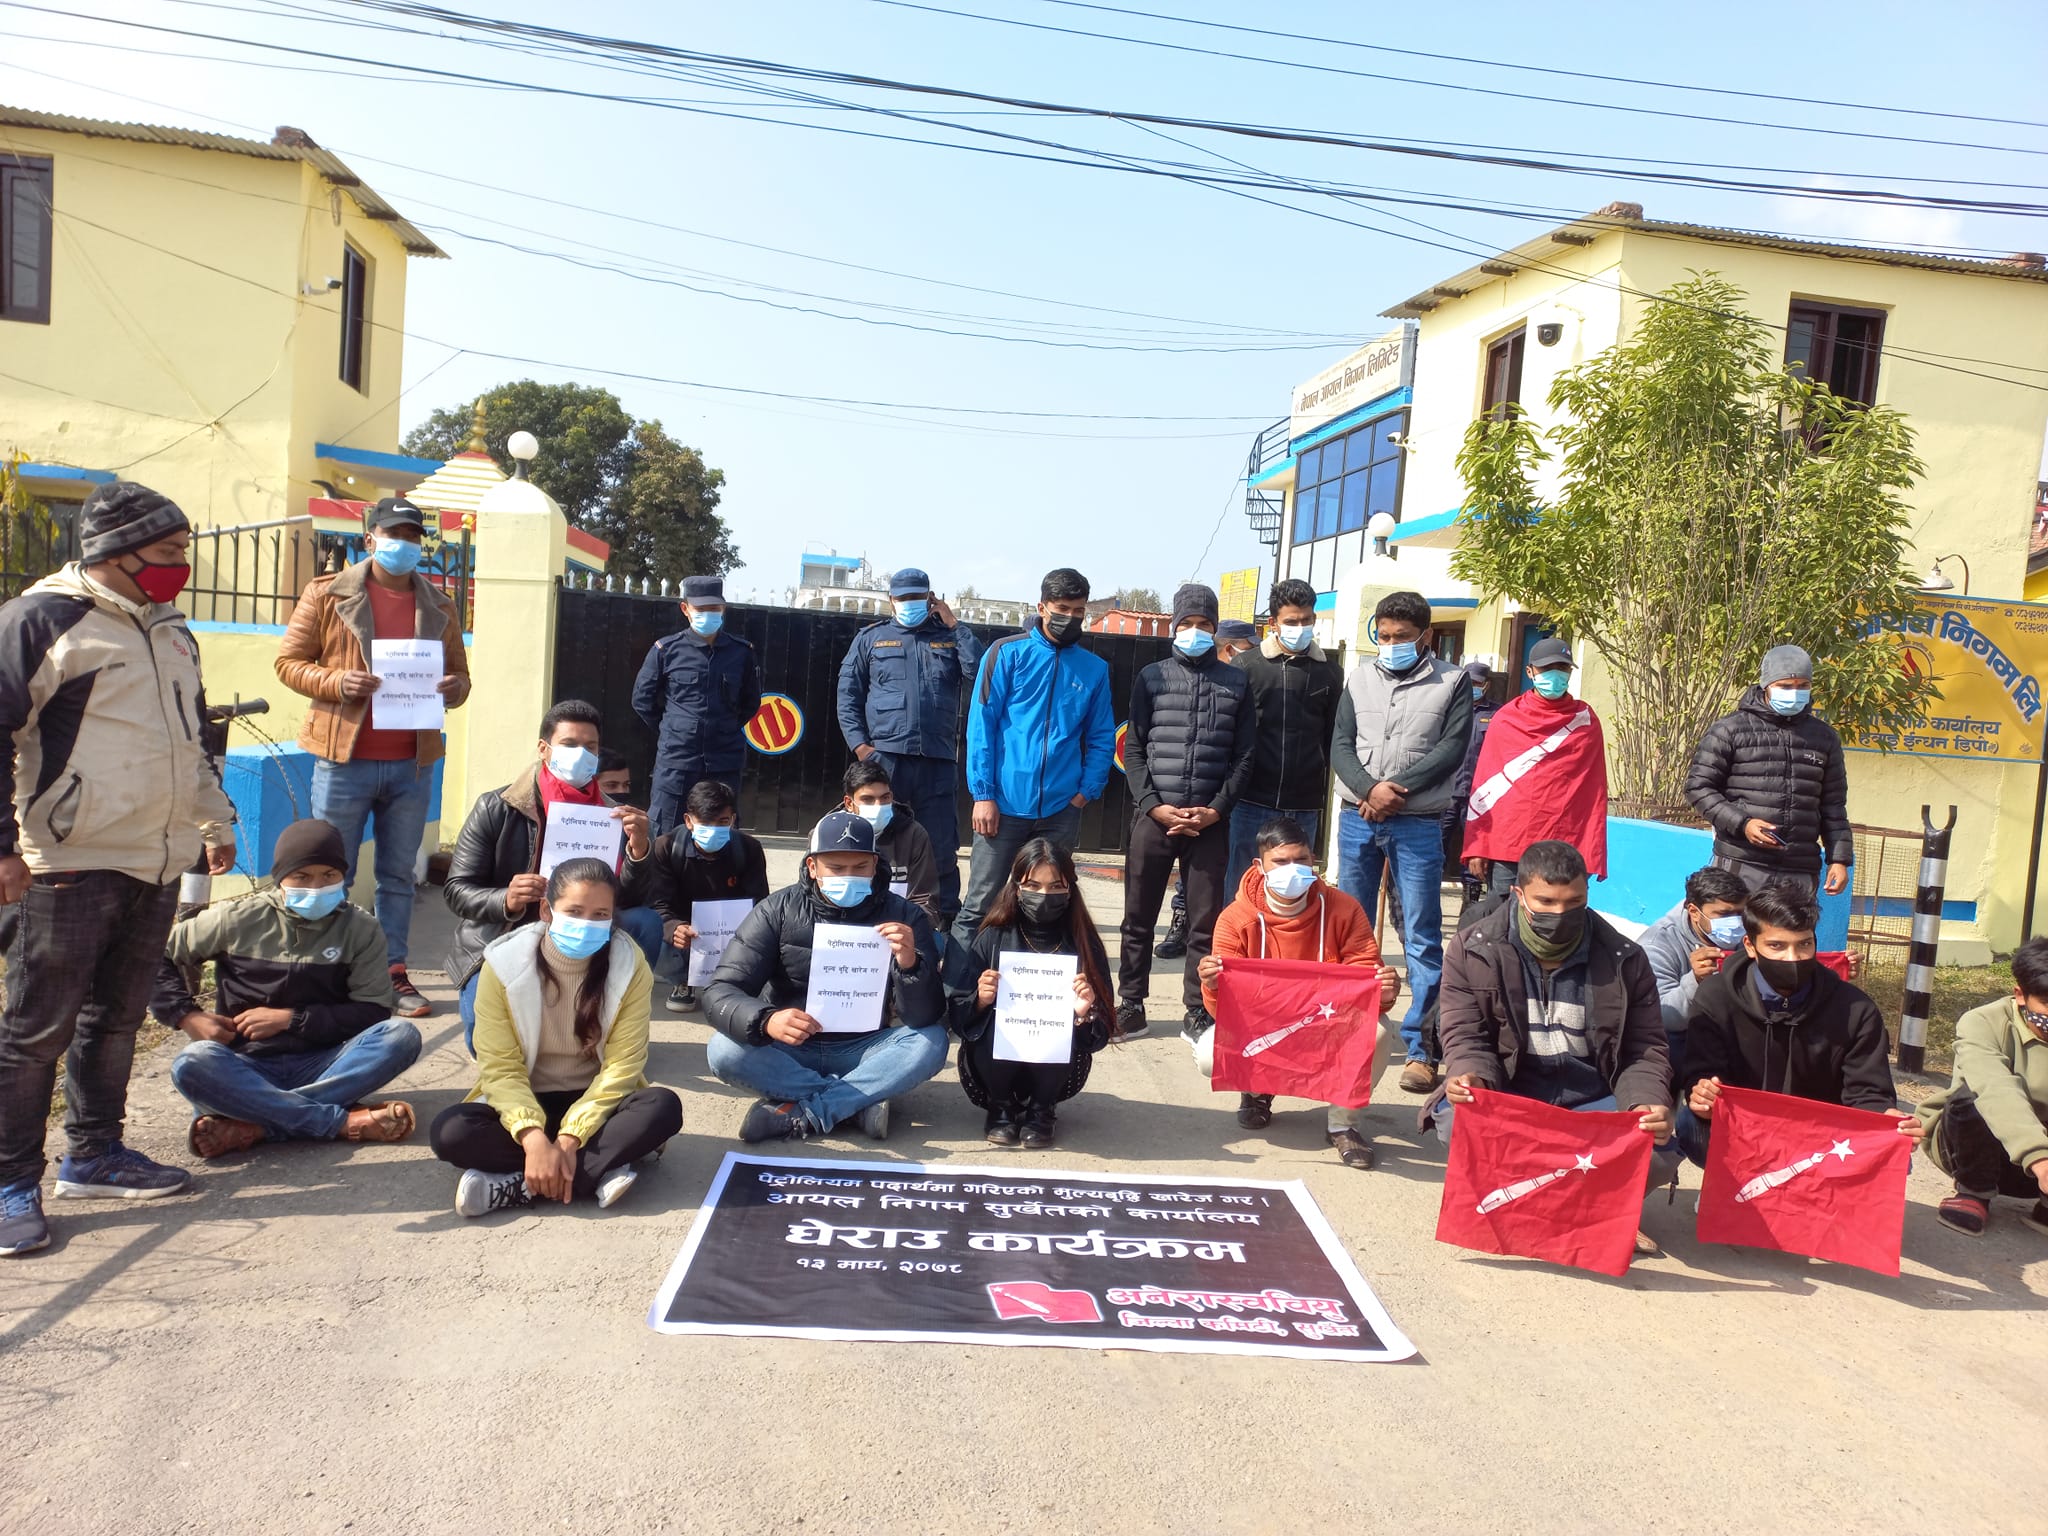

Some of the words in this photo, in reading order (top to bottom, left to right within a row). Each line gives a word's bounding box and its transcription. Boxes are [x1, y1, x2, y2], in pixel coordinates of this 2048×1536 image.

[1301, 393, 1319, 412] नेपाल
[1320, 376, 1343, 401] आयल
[1344, 366, 1366, 389] निगम
[1367, 343, 1400, 377] लिमिटेड
[1940, 611, 2022, 689] निगम
[1931, 715, 2002, 735] कार्यालय
[758, 1172, 863, 1188] पेट्रोलियम
[870, 1180, 956, 1194] पदार्थमा
[963, 1183, 1044, 1196] गरिएको
[1150, 1191, 1213, 1204] खारेज
[1219, 1195, 1254, 1206] गर
[766, 1192, 865, 1209] आयल
[880, 1194, 969, 1214] निगम
[984, 1201, 1113, 1219] सुर्खेतको
[1126, 1207, 1261, 1226] कार्यालय
[785, 1218, 948, 1250] घेराउ
[967, 1229, 1245, 1264] कार्यक्रम
[796, 1257, 826, 1270] १३
[837, 1258, 887, 1272] माघ,
[899, 1259, 963, 1274] २०७८
[1107, 1285, 1349, 1322] अनेरास्ववियु
[1117, 1310, 1195, 1330] जिल्ला
